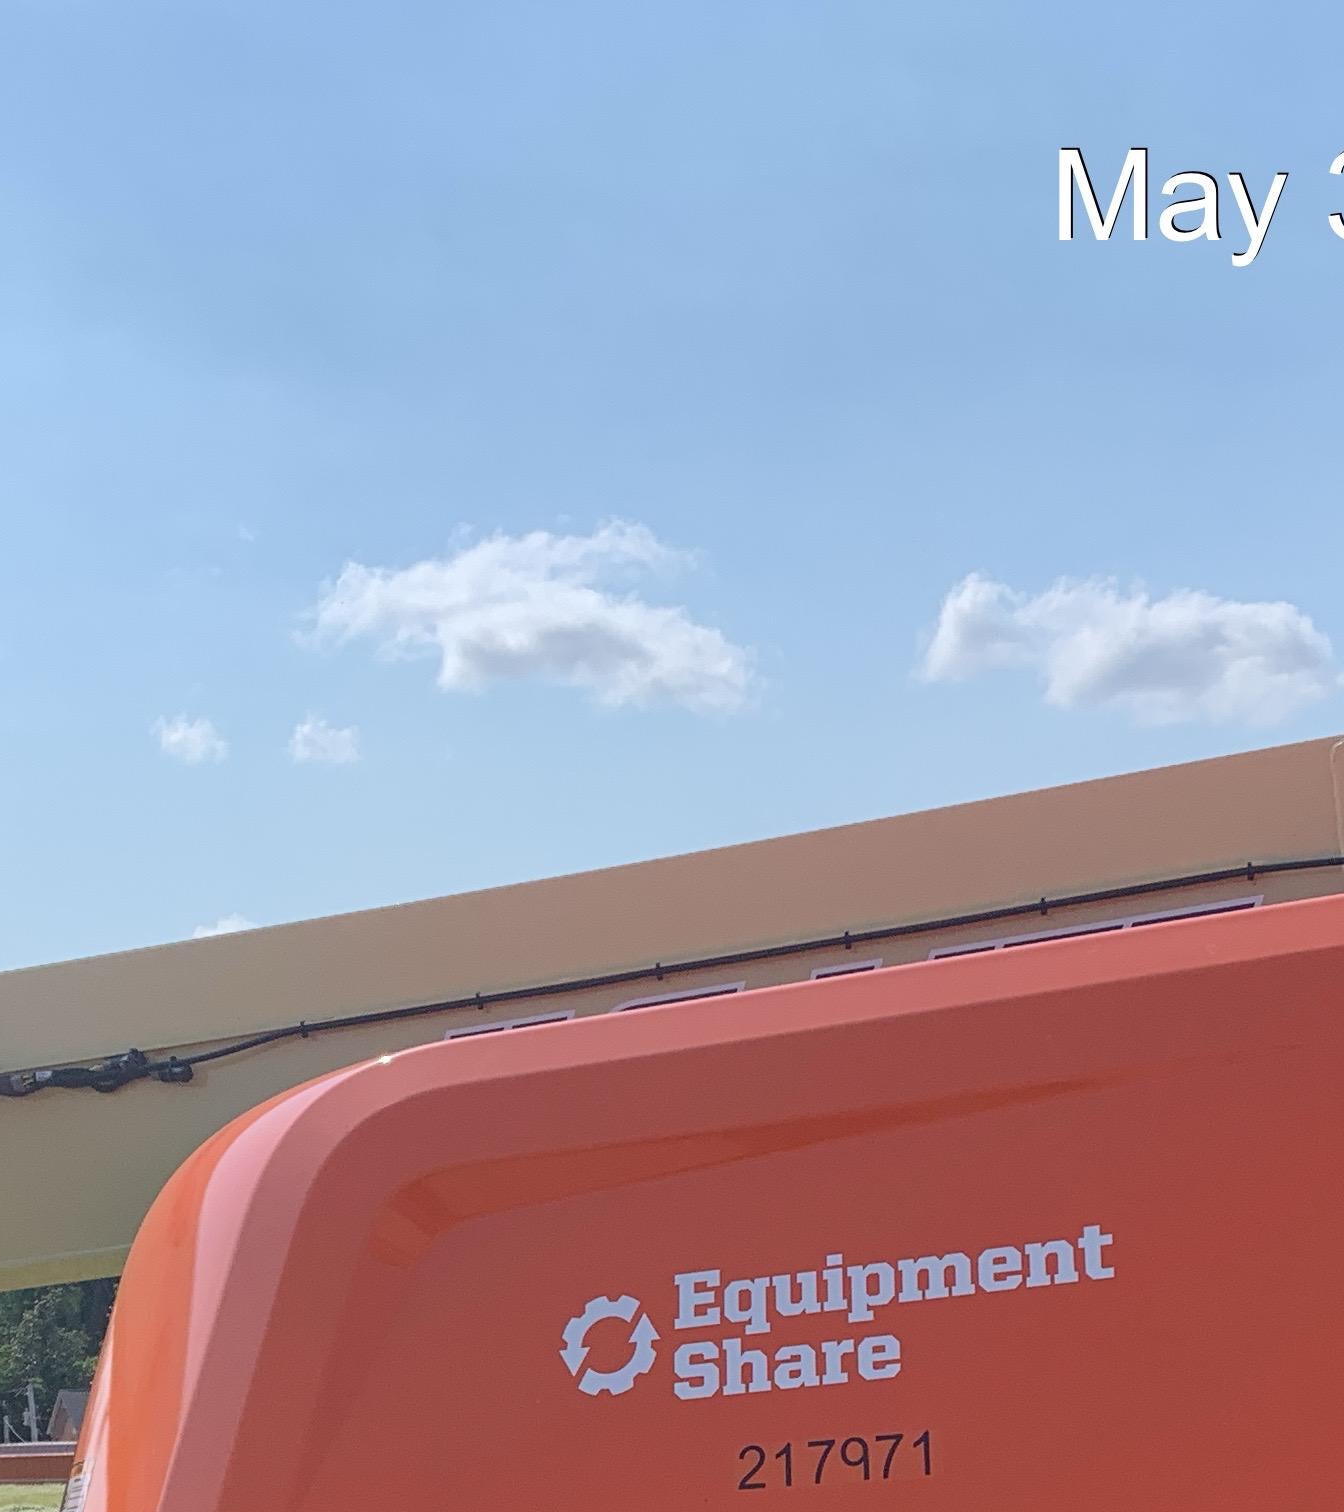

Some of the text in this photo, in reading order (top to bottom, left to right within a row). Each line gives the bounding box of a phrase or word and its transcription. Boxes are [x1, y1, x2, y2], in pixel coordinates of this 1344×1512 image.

[673, 1224, 1115, 1335] Equipment
[673, 1334, 901, 1401] Share
[737, 1429, 932, 1491] 217971
